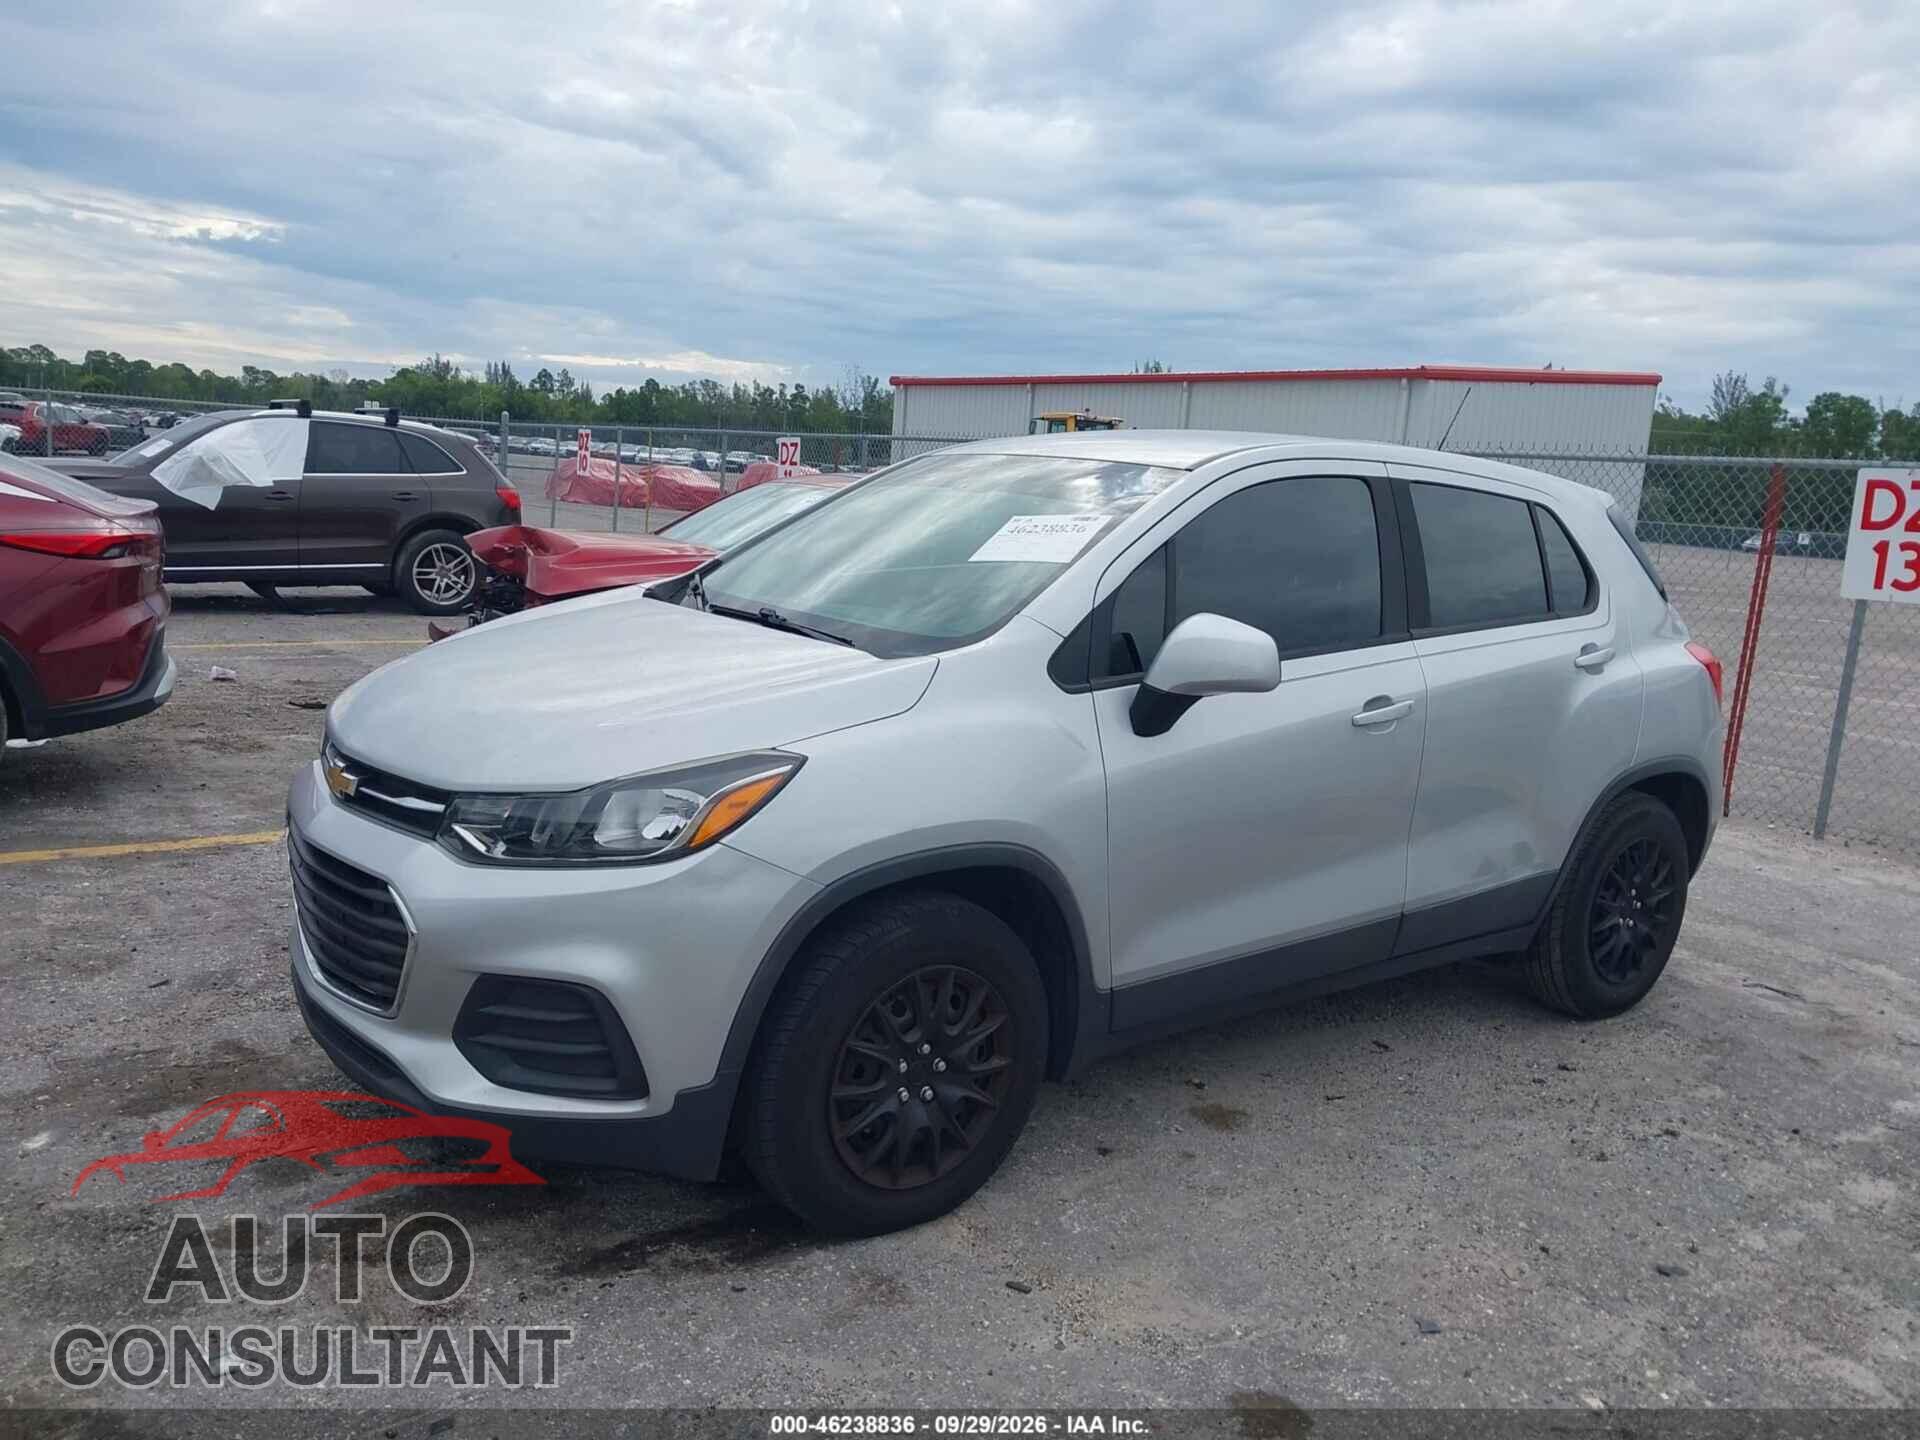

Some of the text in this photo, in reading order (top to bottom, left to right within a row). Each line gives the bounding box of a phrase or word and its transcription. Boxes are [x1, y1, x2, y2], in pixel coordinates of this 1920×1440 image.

[579, 432, 590, 451] DZ
[578, 453, 588, 472] 10
[780, 442, 799, 466] DZ
[1872, 540, 1920, 592] 13
